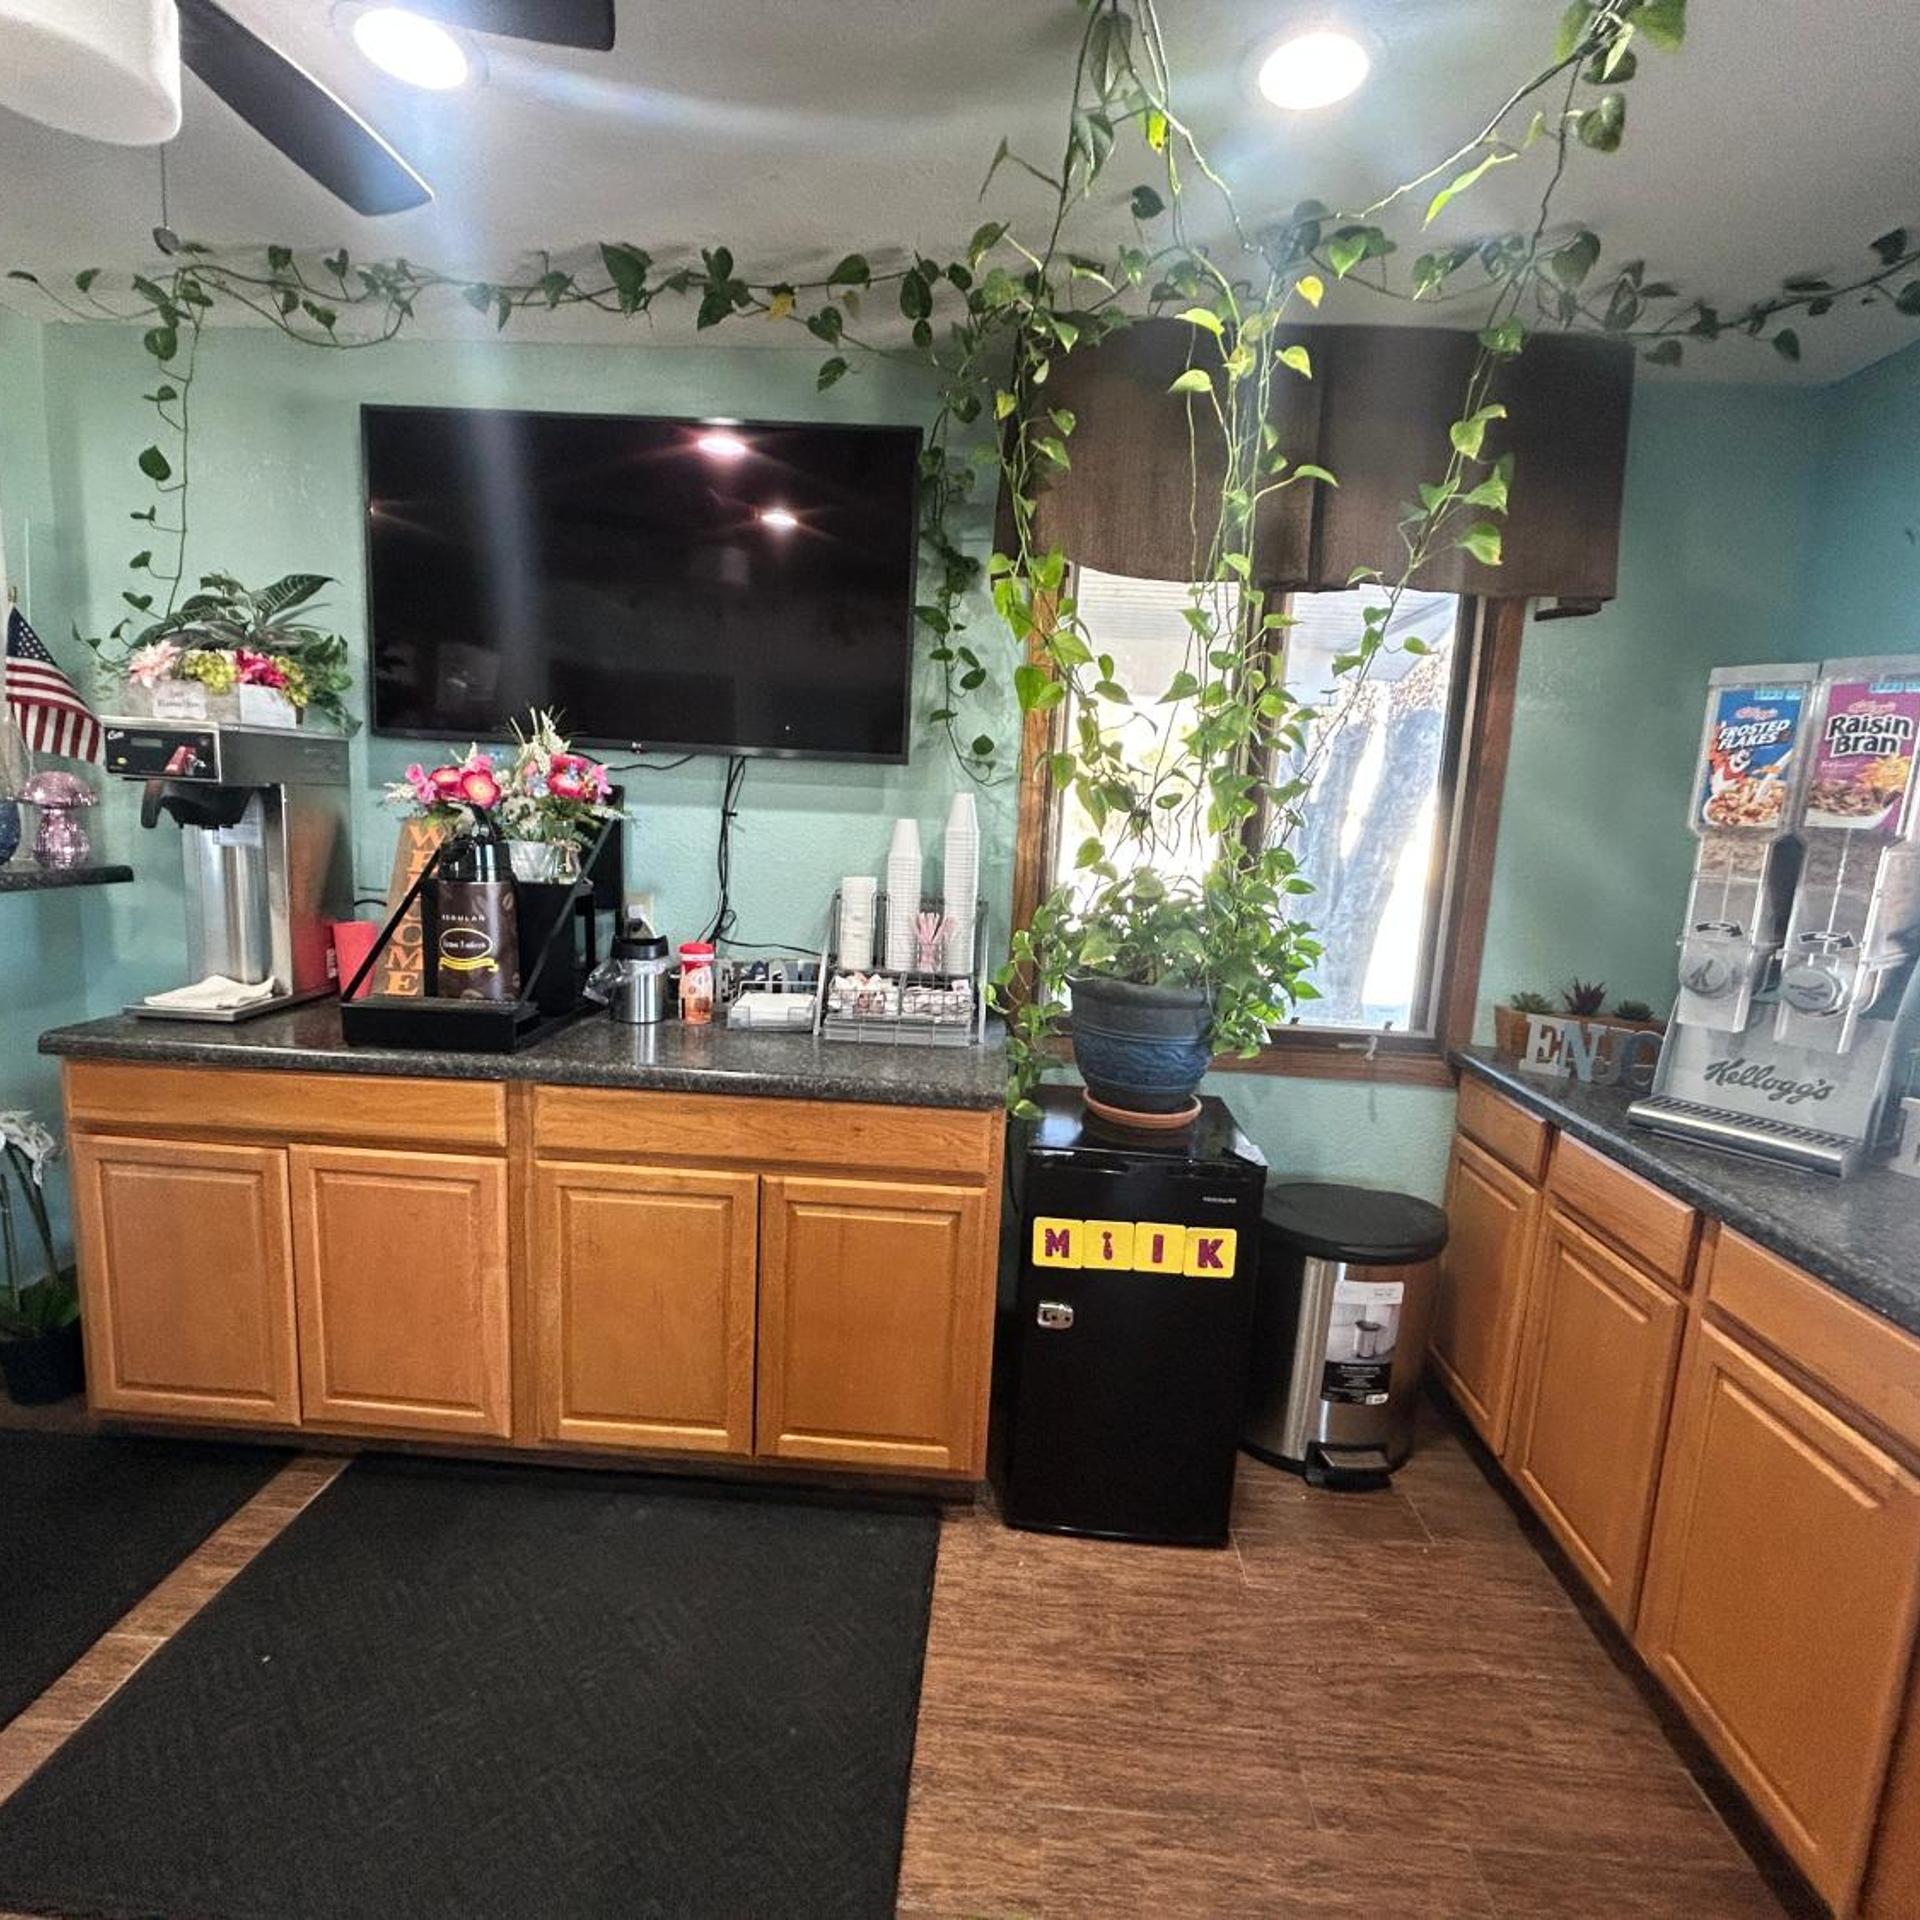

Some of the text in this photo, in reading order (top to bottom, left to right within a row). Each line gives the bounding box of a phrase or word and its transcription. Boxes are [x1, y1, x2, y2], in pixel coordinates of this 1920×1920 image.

[1719, 719, 1790, 740] FROSTED
[1827, 714, 1912, 739] Raisin
[1718, 732, 1779, 751] FLAKES
[1833, 734, 1898, 756] Bran
[1704, 1058, 1835, 1104] Kellogg's
